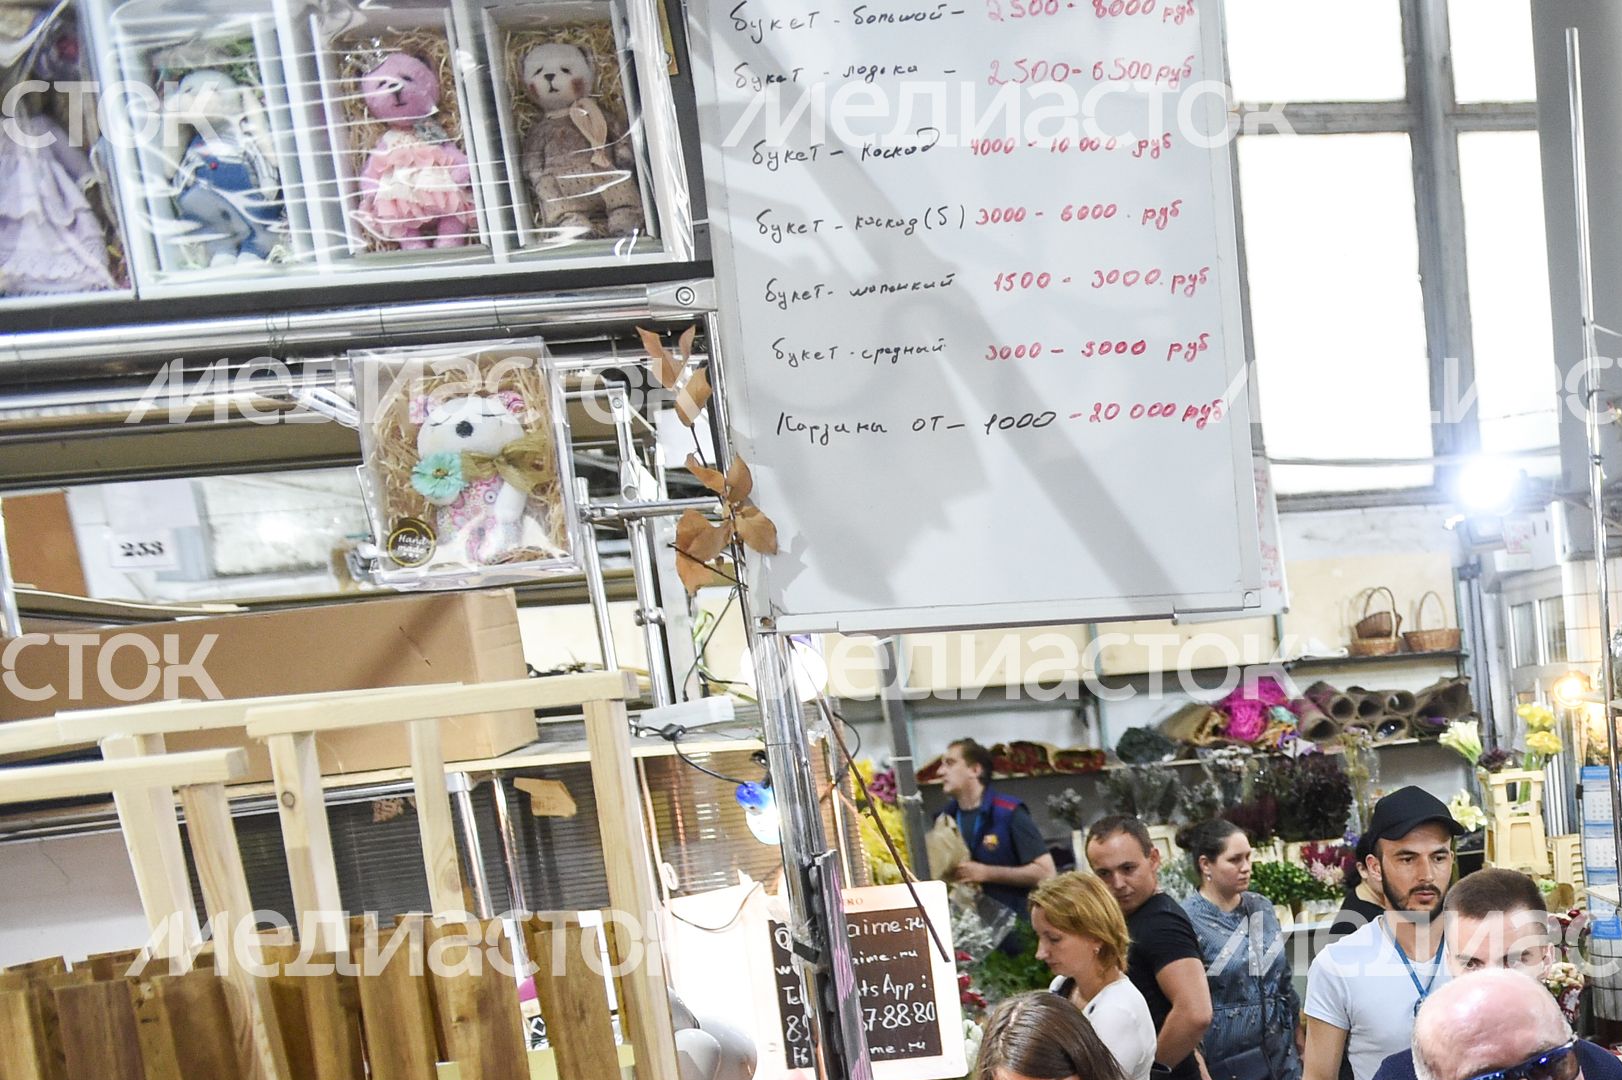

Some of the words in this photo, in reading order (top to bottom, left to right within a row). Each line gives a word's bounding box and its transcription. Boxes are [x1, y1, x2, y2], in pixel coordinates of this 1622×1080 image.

[1163, 1, 1196, 25] руб
[1156, 56, 1195, 90] руб
[1132, 133, 1172, 160] руб
[975, 207, 1027, 225] 3000
[1142, 199, 1183, 230] руб
[993, 271, 1051, 292] 1500
[1171, 266, 1210, 297] руб
[985, 342, 1042, 361] 3000
[1167, 333, 1210, 362] руб
[398, 534, 426, 545] Hand
[398, 545, 425, 553] made
